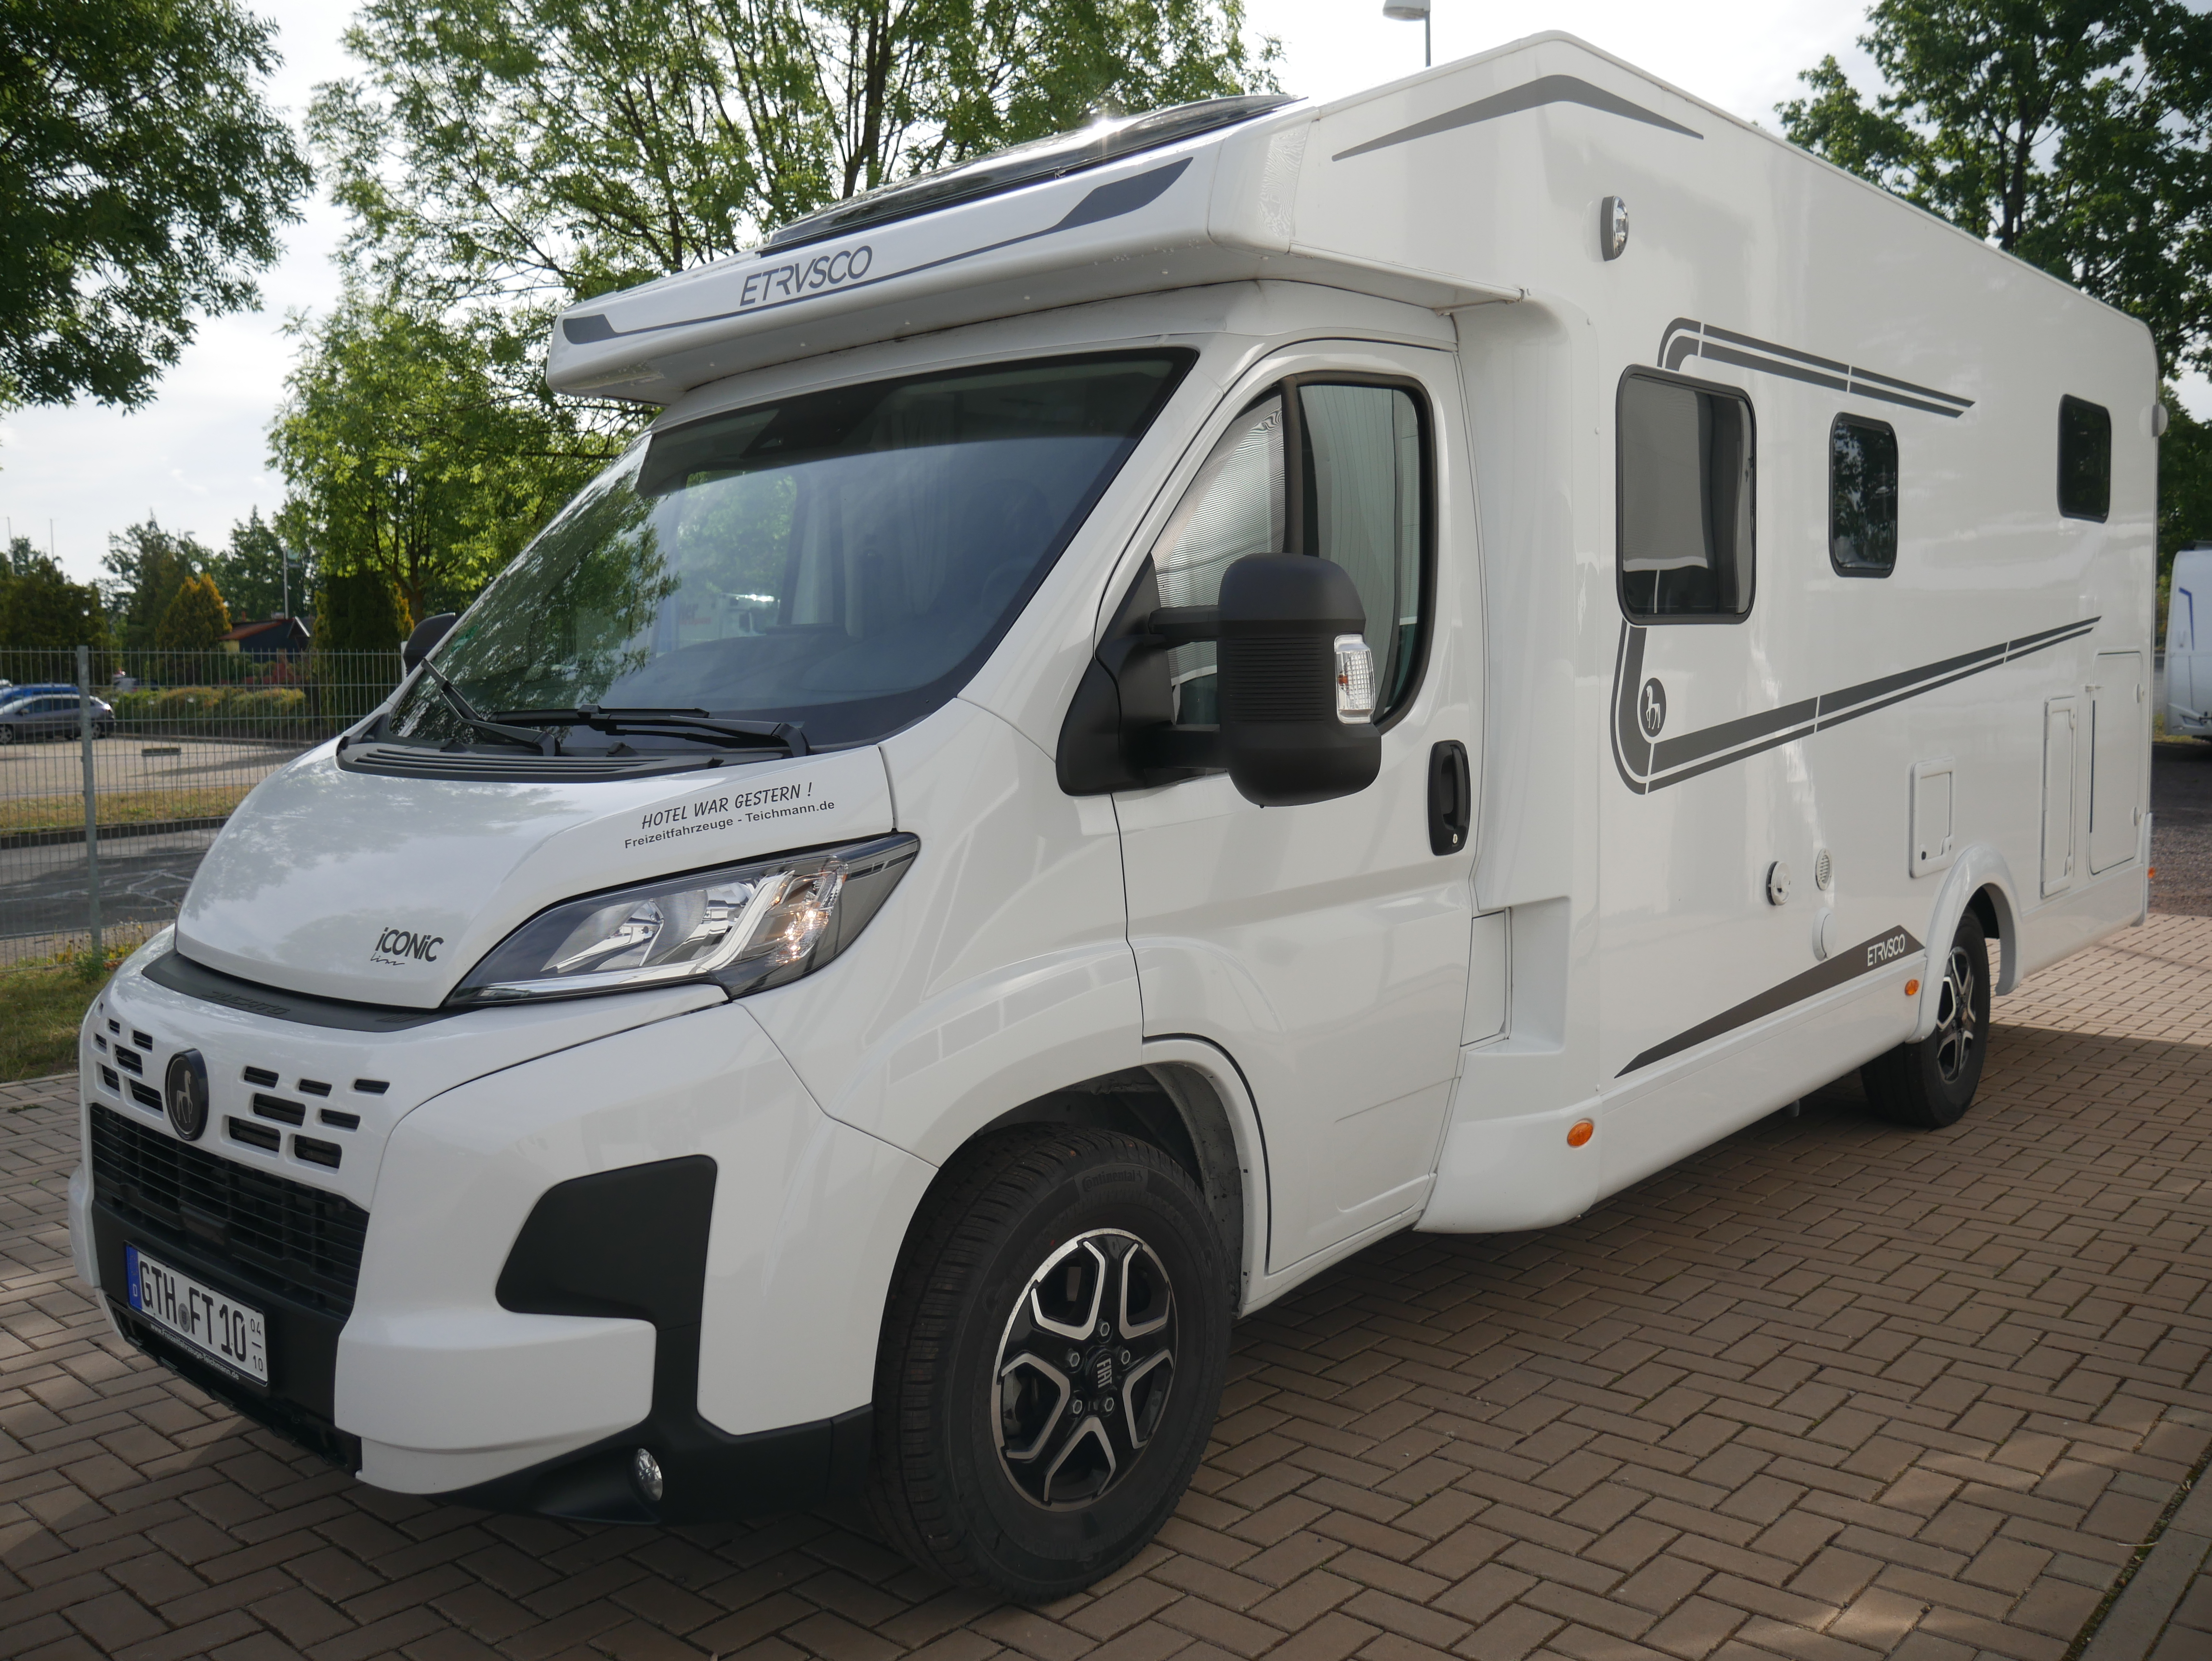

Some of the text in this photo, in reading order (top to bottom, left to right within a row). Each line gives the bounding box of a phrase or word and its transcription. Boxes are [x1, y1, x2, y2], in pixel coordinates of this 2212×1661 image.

[642, 805, 688, 829] HOTEL
[694, 797, 729, 817] WAR
[735, 783, 801, 809] GESTERN
[624, 818, 733, 849] Freizeitfahrzeuge
[745, 801, 835, 822] Teichmann.de
[132, 1283, 138, 1297] D
[139, 1260, 177, 1324] GTH
[250, 1318, 262, 1336] 04
[253, 1354, 263, 1372] 10
[1096, 1358, 1112, 1388] FIAT
